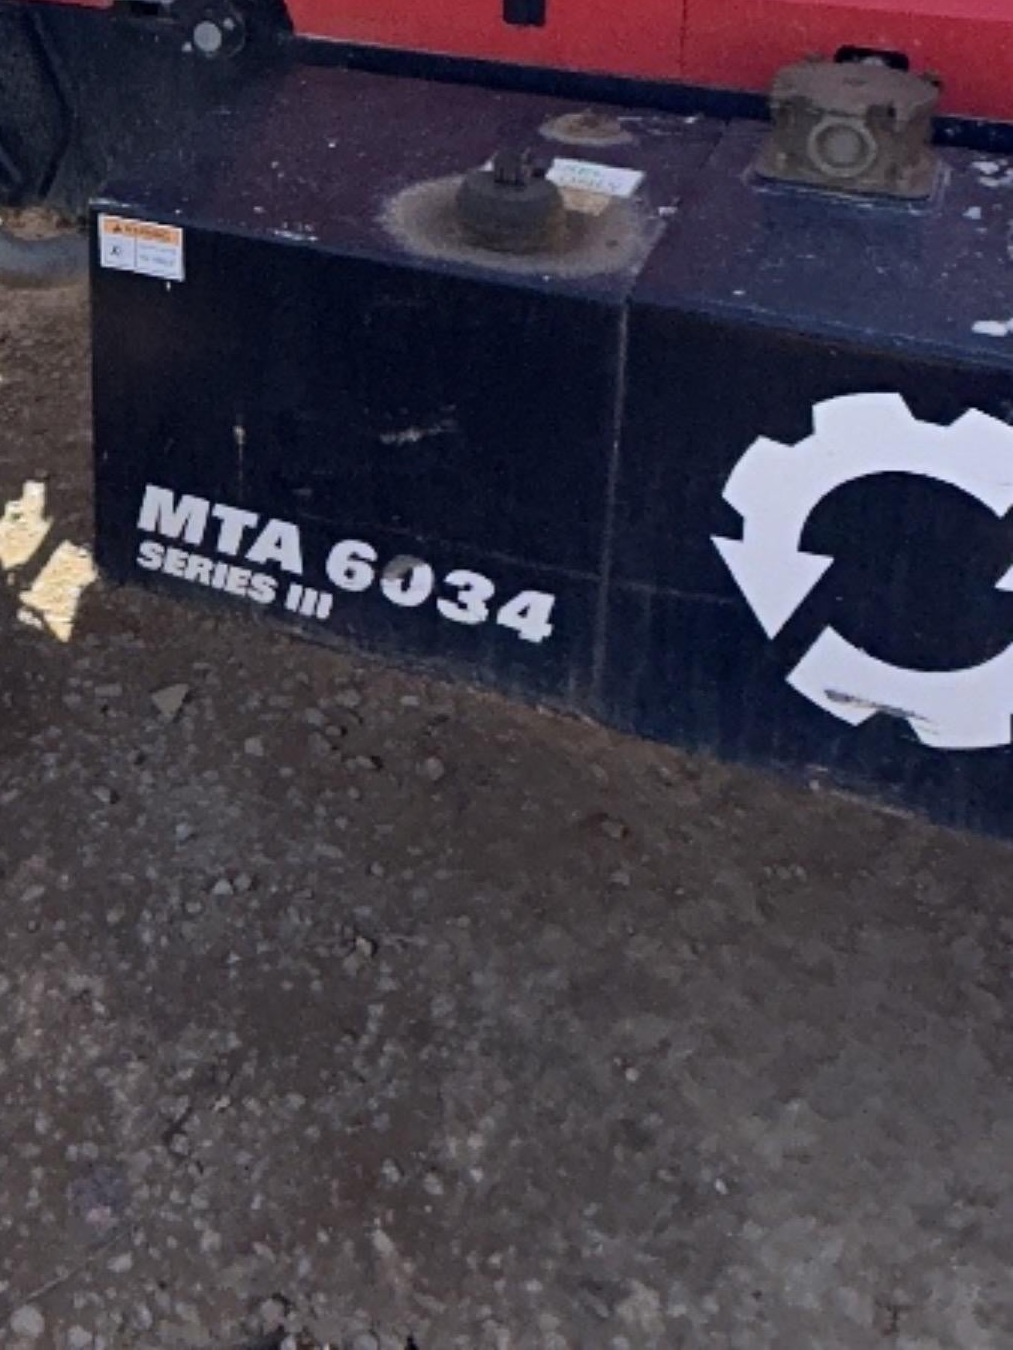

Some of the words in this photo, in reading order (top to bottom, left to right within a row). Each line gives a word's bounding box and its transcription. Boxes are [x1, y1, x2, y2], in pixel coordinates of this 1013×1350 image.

[136, 540, 279, 605] SERIES
[284, 582, 334, 621] III
[137, 483, 304, 576] MTA
[324, 538, 557, 644] 6034
